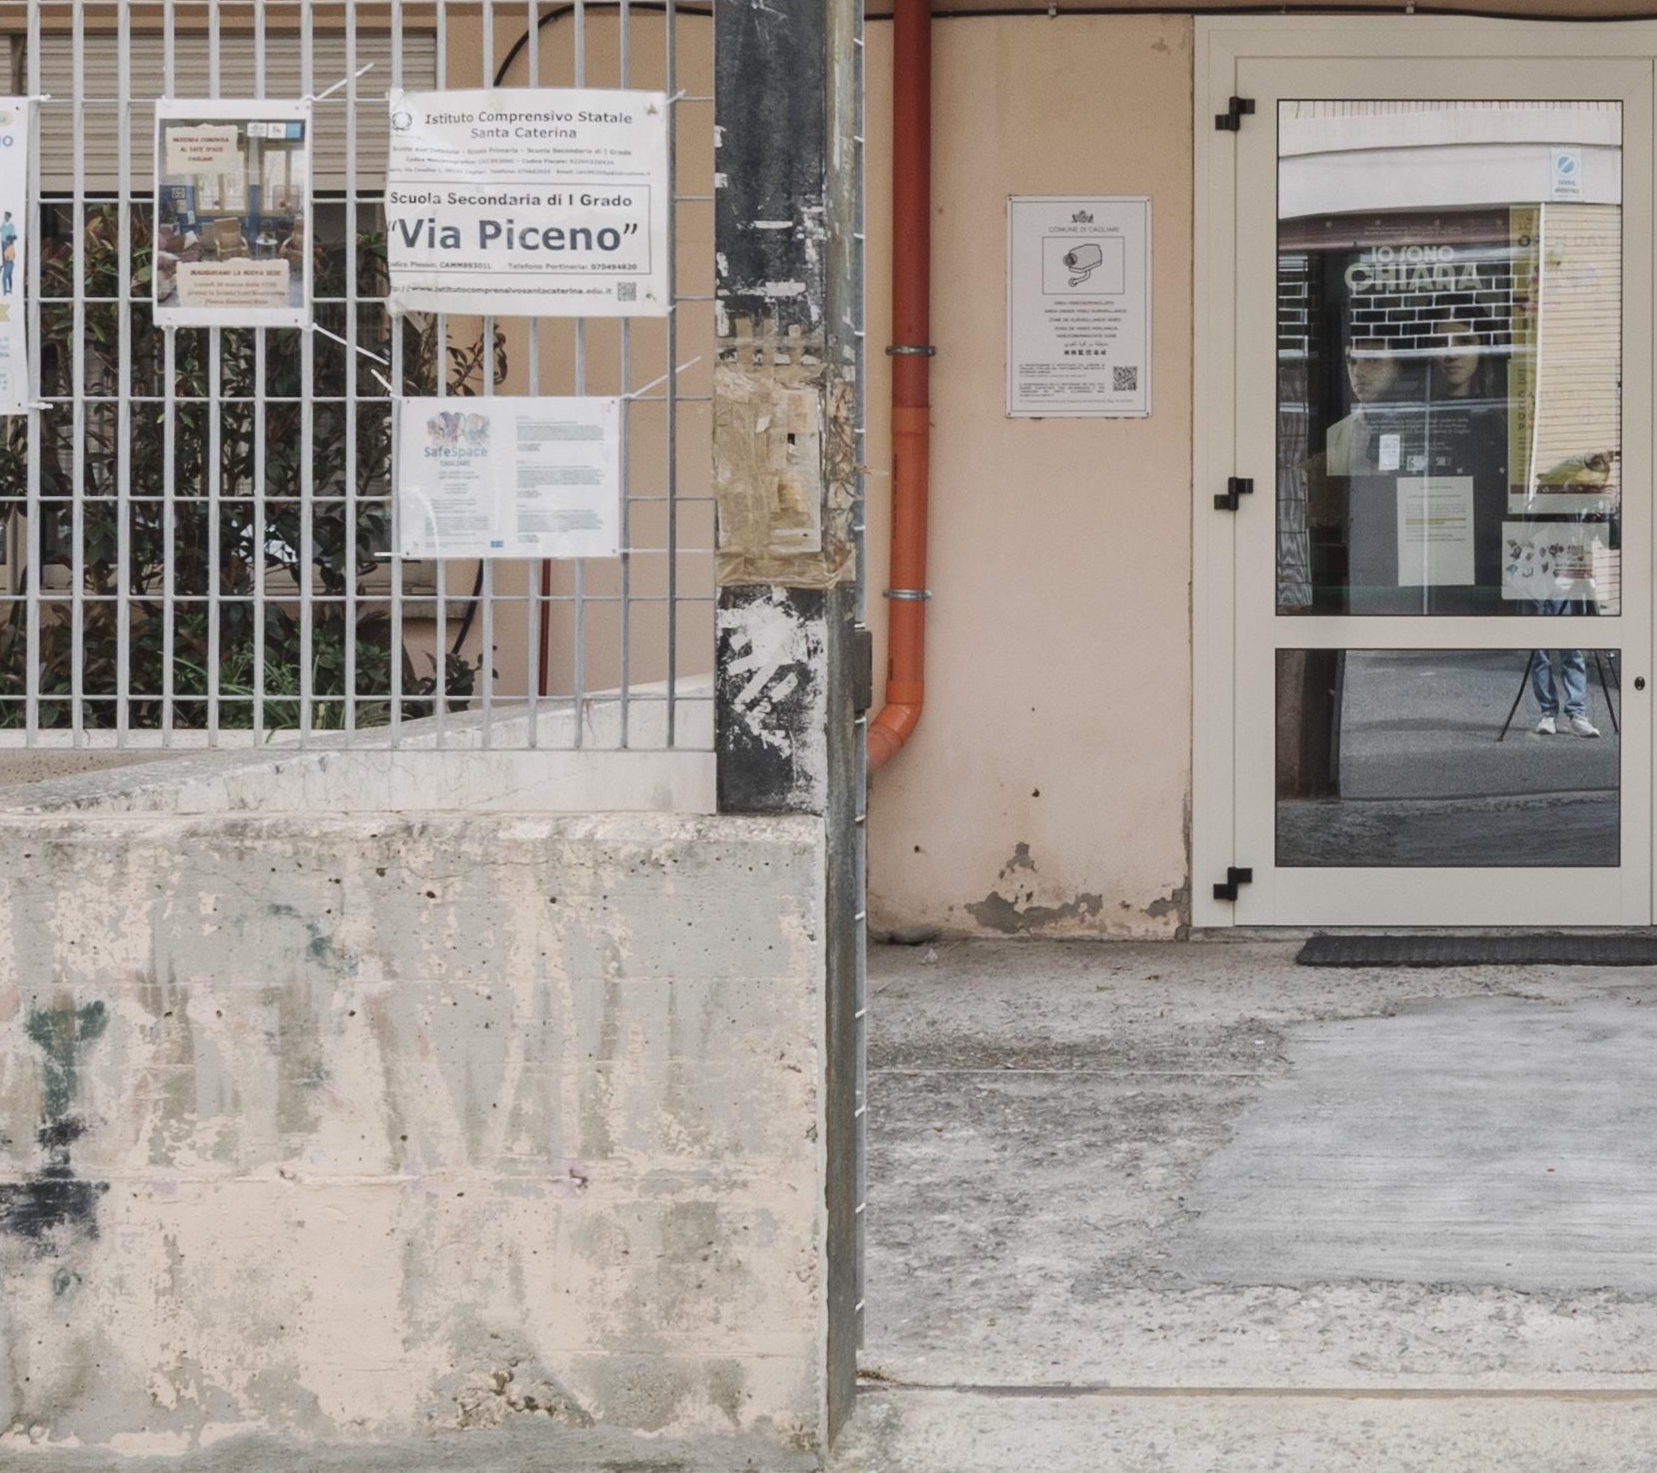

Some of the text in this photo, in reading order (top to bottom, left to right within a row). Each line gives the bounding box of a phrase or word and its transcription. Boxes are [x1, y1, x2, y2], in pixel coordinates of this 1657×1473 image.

[424, 110, 633, 125] Istituto Comprensivo Statale
[470, 127, 577, 139] Santa Caterina
[390, 191, 633, 207] Scuola Secondaria di I Grado
[1371, 245, 1455, 263] IO SONO
[1344, 262, 1484, 292] CHIARA
[424, 446, 488, 458] SafeSpace
